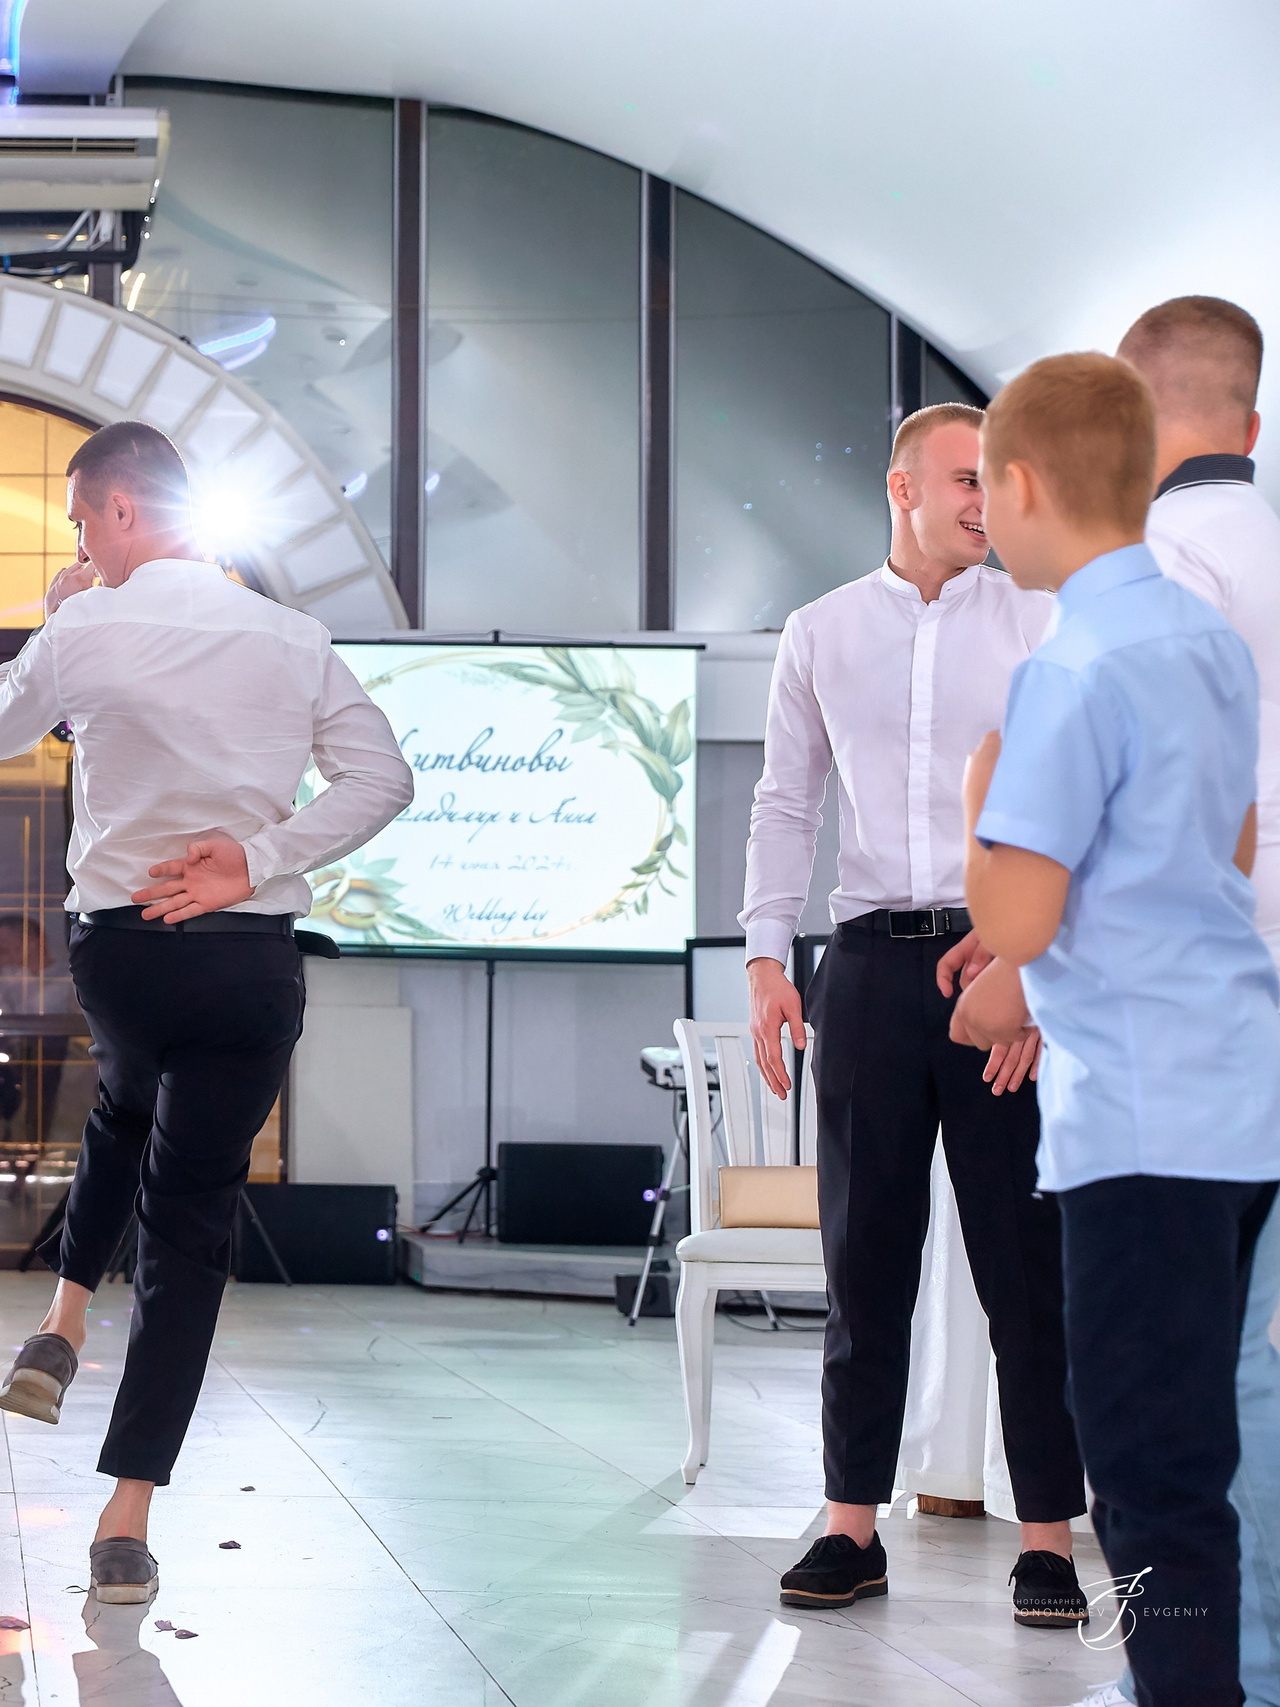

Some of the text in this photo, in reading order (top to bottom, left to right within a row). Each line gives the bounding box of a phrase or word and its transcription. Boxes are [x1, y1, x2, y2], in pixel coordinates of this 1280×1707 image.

[508, 810, 521, 823] и
[529, 796, 598, 824] Анна
[429, 854, 454, 870] 14
[443, 897, 518, 935] Wedding
